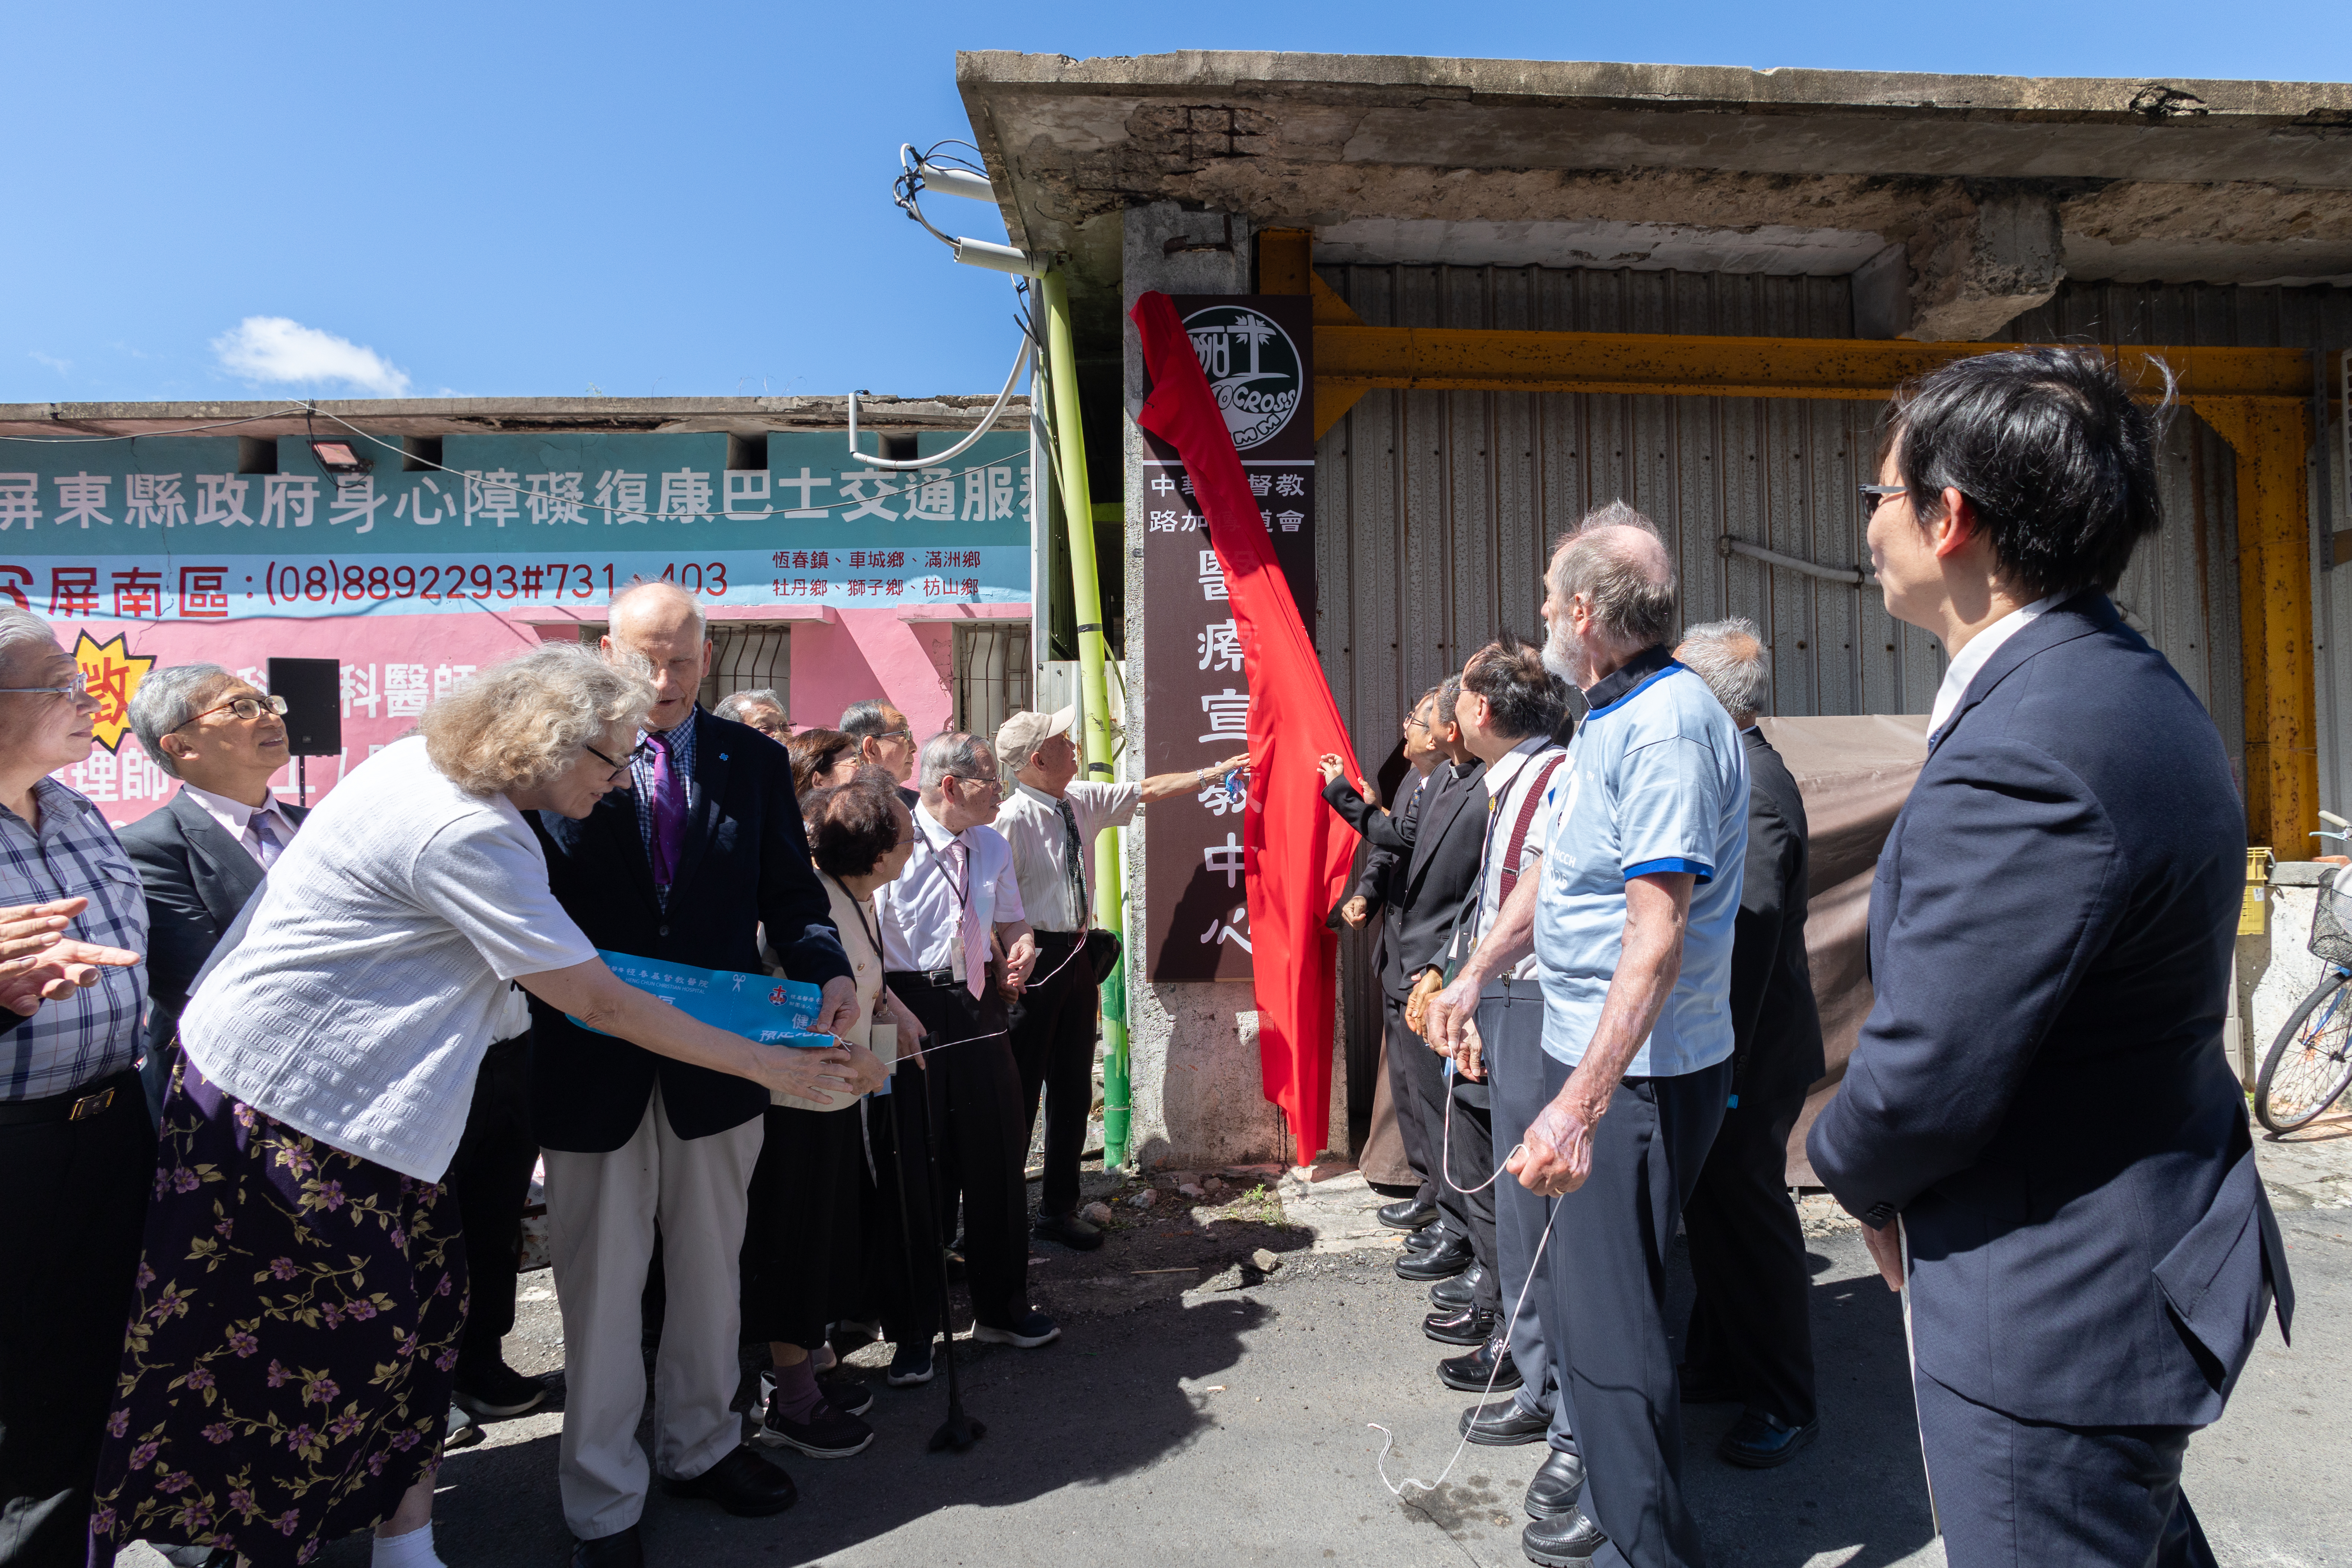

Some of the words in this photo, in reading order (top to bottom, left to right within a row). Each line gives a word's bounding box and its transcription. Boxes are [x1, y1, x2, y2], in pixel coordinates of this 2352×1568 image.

[1229, 414, 1281, 444] MM
[772, 578, 979, 597] 牡丹鄉、獅子鄉、枋山鄉
[48, 747, 169, 801] 理師
[1586, 770, 1595, 782] TH
[1554, 848, 1576, 868] HCCH
[626, 968, 709, 988] 恆春基督教醫院
[656, 982, 681, 991] CHRISTIAN
